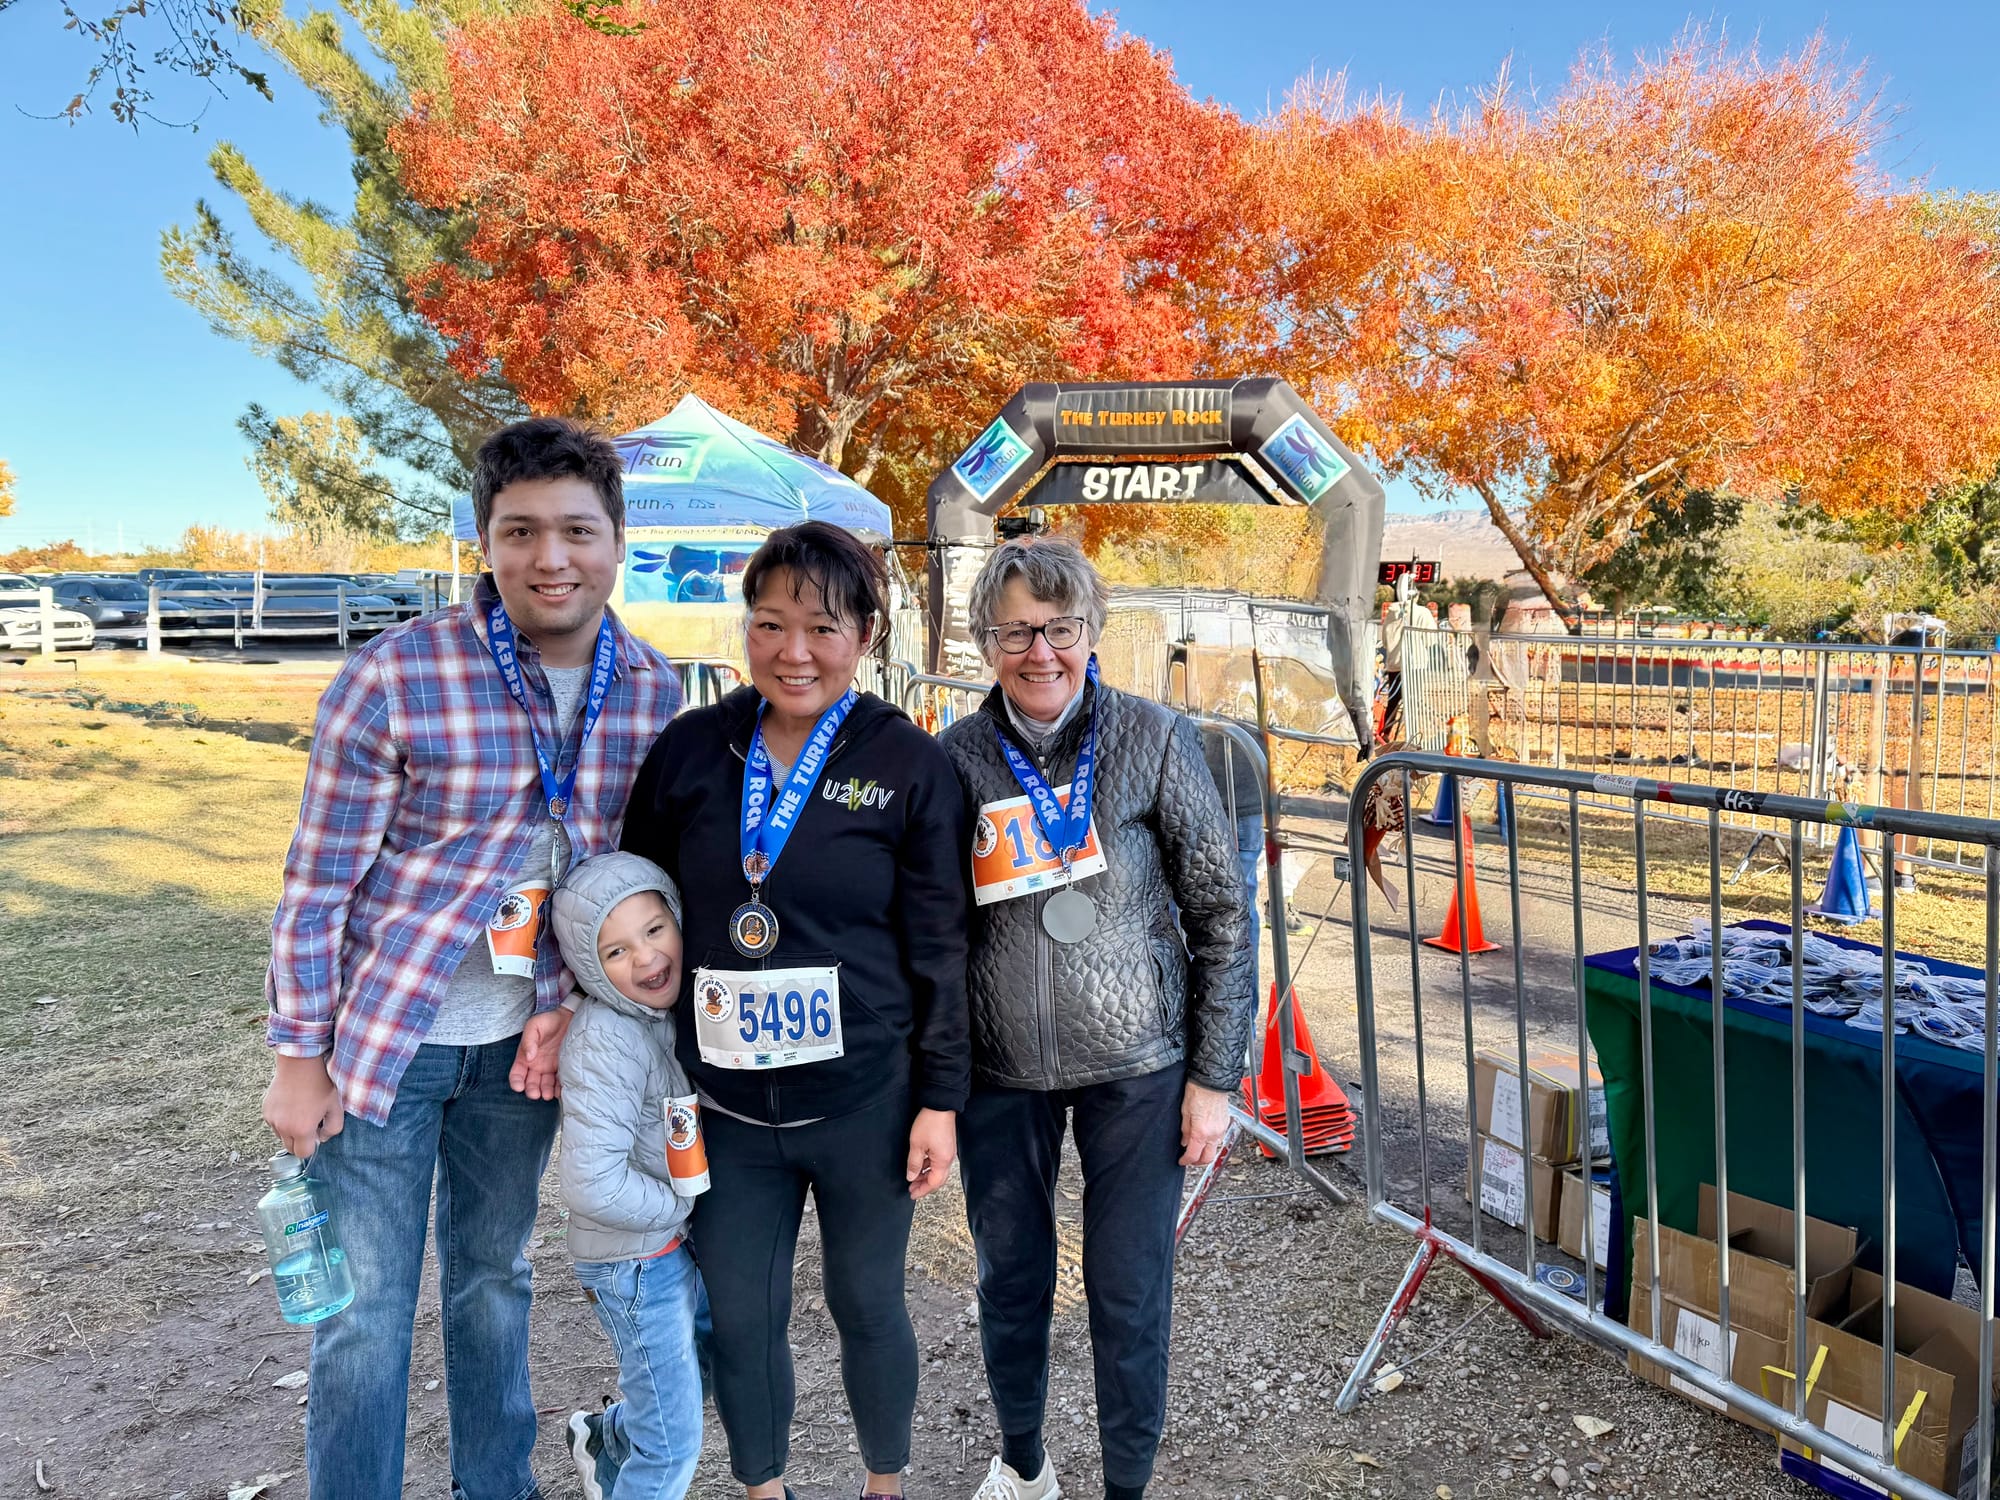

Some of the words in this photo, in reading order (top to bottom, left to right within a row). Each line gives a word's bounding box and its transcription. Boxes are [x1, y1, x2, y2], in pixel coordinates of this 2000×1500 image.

[1060, 410, 1092, 426] THE
[1097, 410, 1166, 426] TURKEY
[1172, 410, 1222, 425] ROCK
[638, 453, 682, 468] Run
[995, 447, 1018, 468] Run
[1081, 466, 1204, 500] START
[1296, 468, 1314, 491] Run
[770, 789, 801, 831] THE
[792, 710, 840, 787] TURKEY
[1071, 763, 1090, 821] ROCK
[746, 776, 767, 833] ROCK
[1023, 774, 1061, 826] ROCK
[740, 988, 831, 1043] 5496
